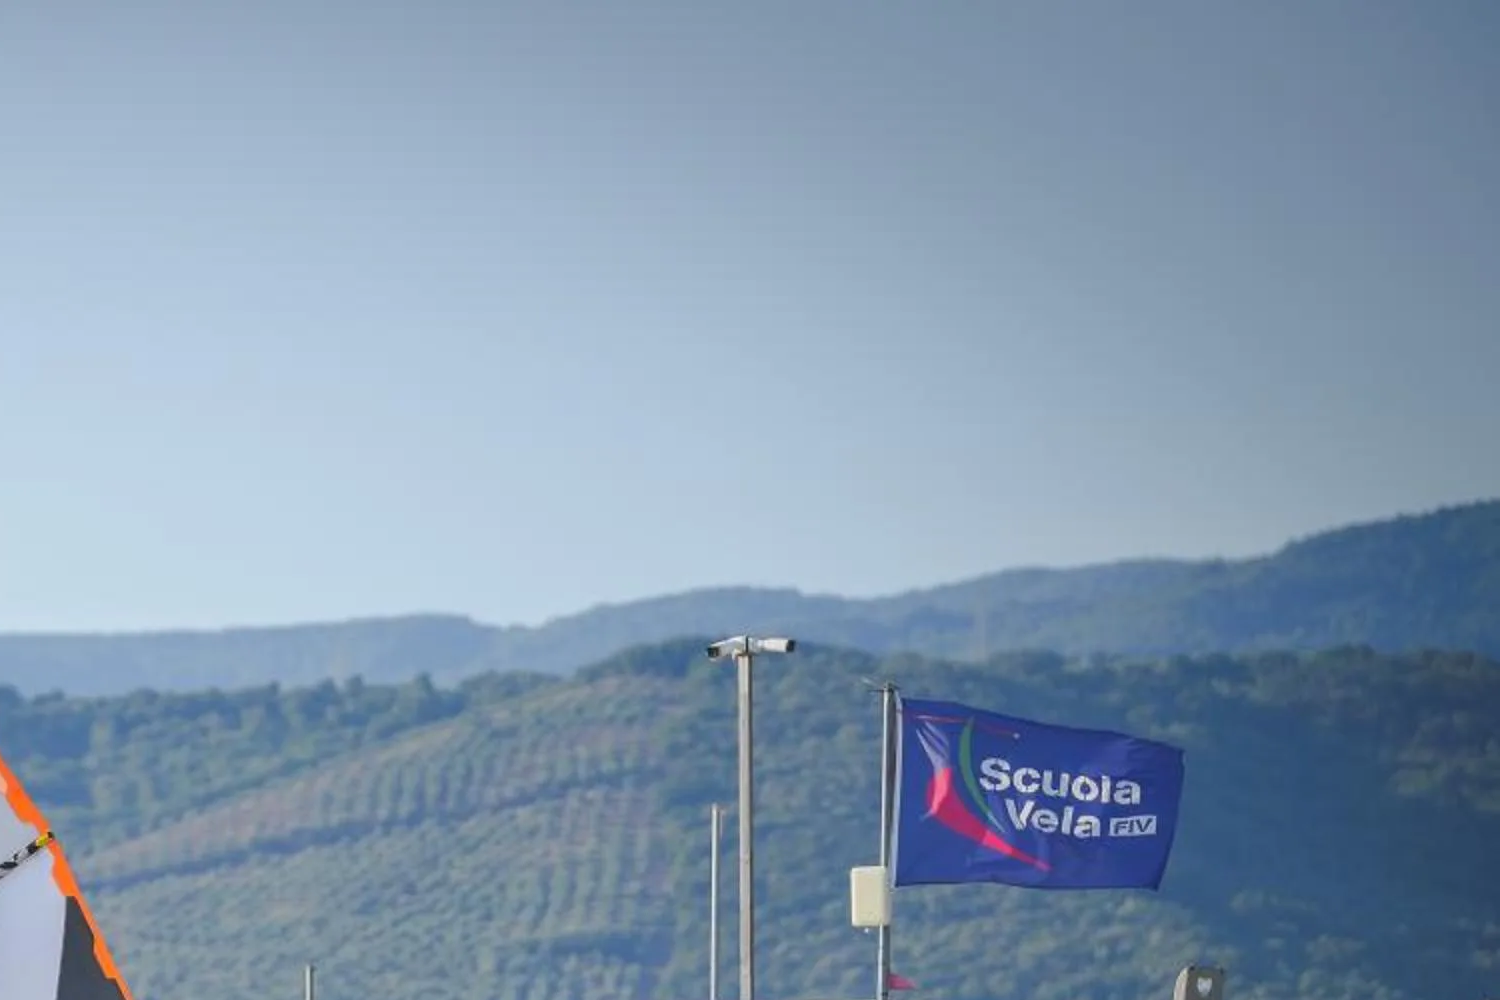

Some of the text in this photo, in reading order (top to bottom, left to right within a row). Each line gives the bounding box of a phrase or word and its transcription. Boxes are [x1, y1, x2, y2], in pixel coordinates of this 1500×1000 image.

[979, 757, 1142, 806] Scuola
[1004, 798, 1155, 839] Vela FIV
